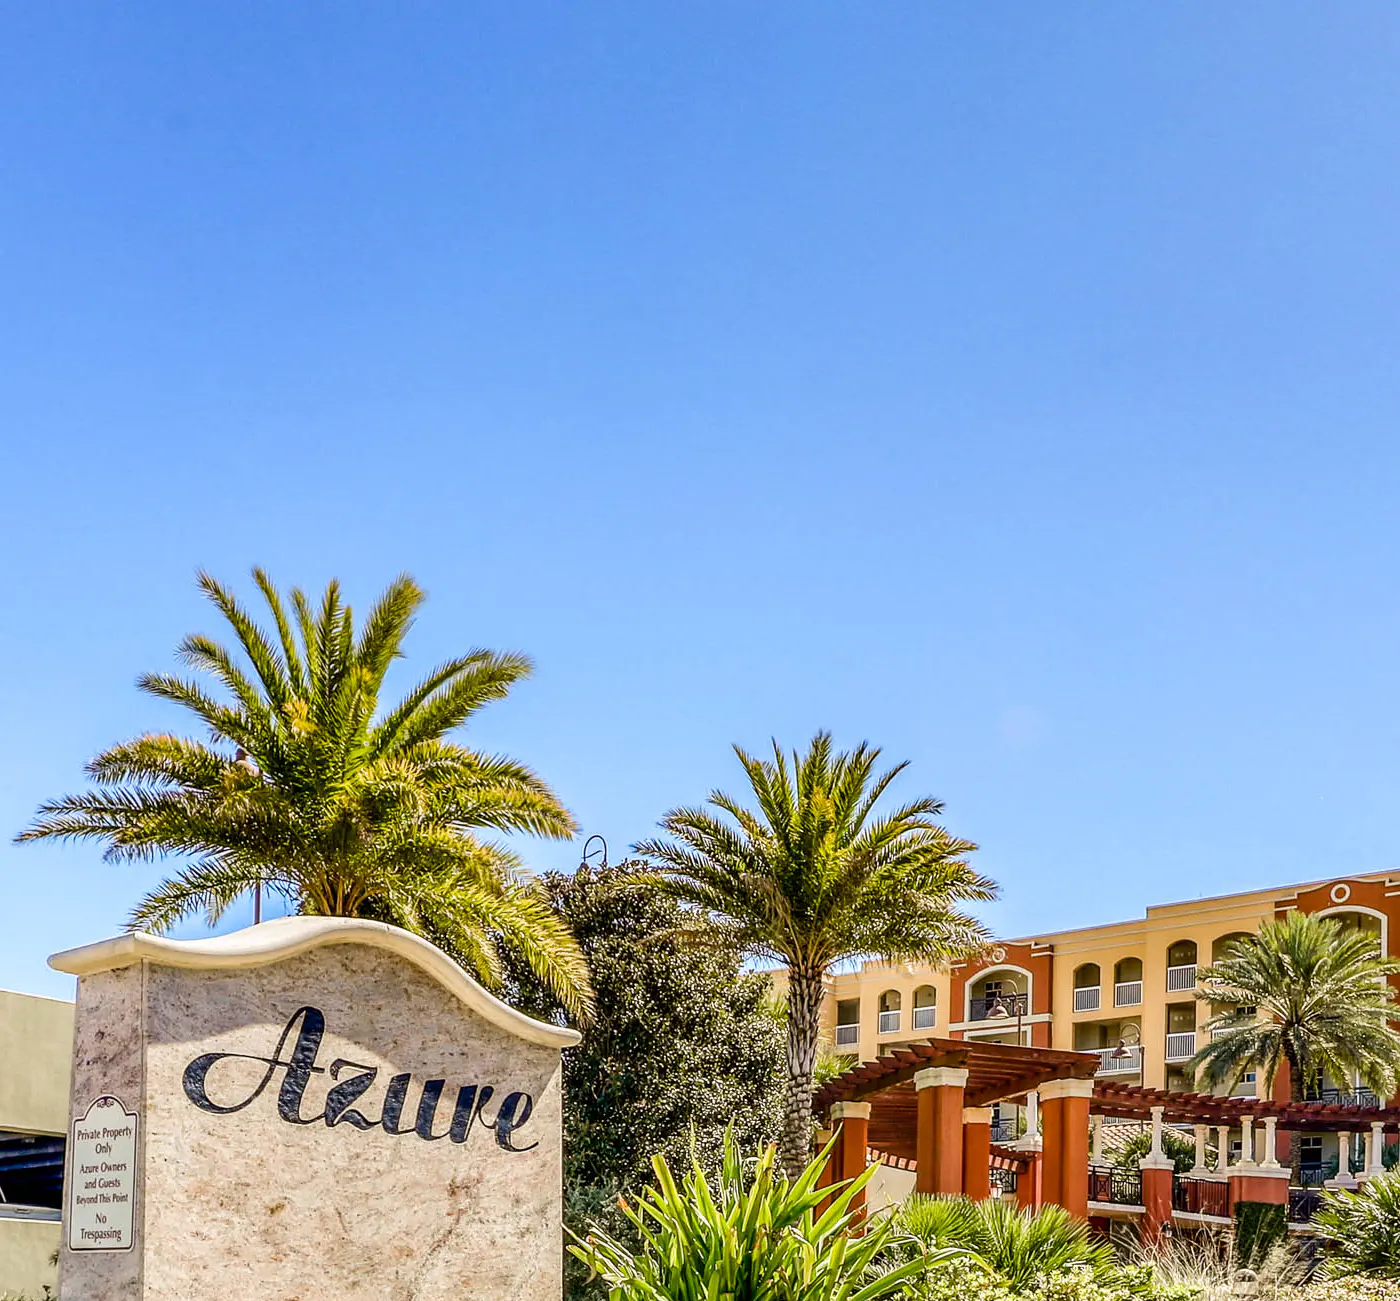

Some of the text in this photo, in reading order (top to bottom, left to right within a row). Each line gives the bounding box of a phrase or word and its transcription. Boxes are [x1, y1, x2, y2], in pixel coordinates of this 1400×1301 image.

[182, 1006, 539, 1153] Azure
[77, 1126, 133, 1141] Private Property
[95, 1142, 112, 1157] Only
[79, 1161, 127, 1174] Azure Owners
[84, 1177, 121, 1189] and Guests
[76, 1192, 129, 1208] Beyond This Point
[95, 1213, 107, 1224] No
[80, 1226, 122, 1243] Trespassing
